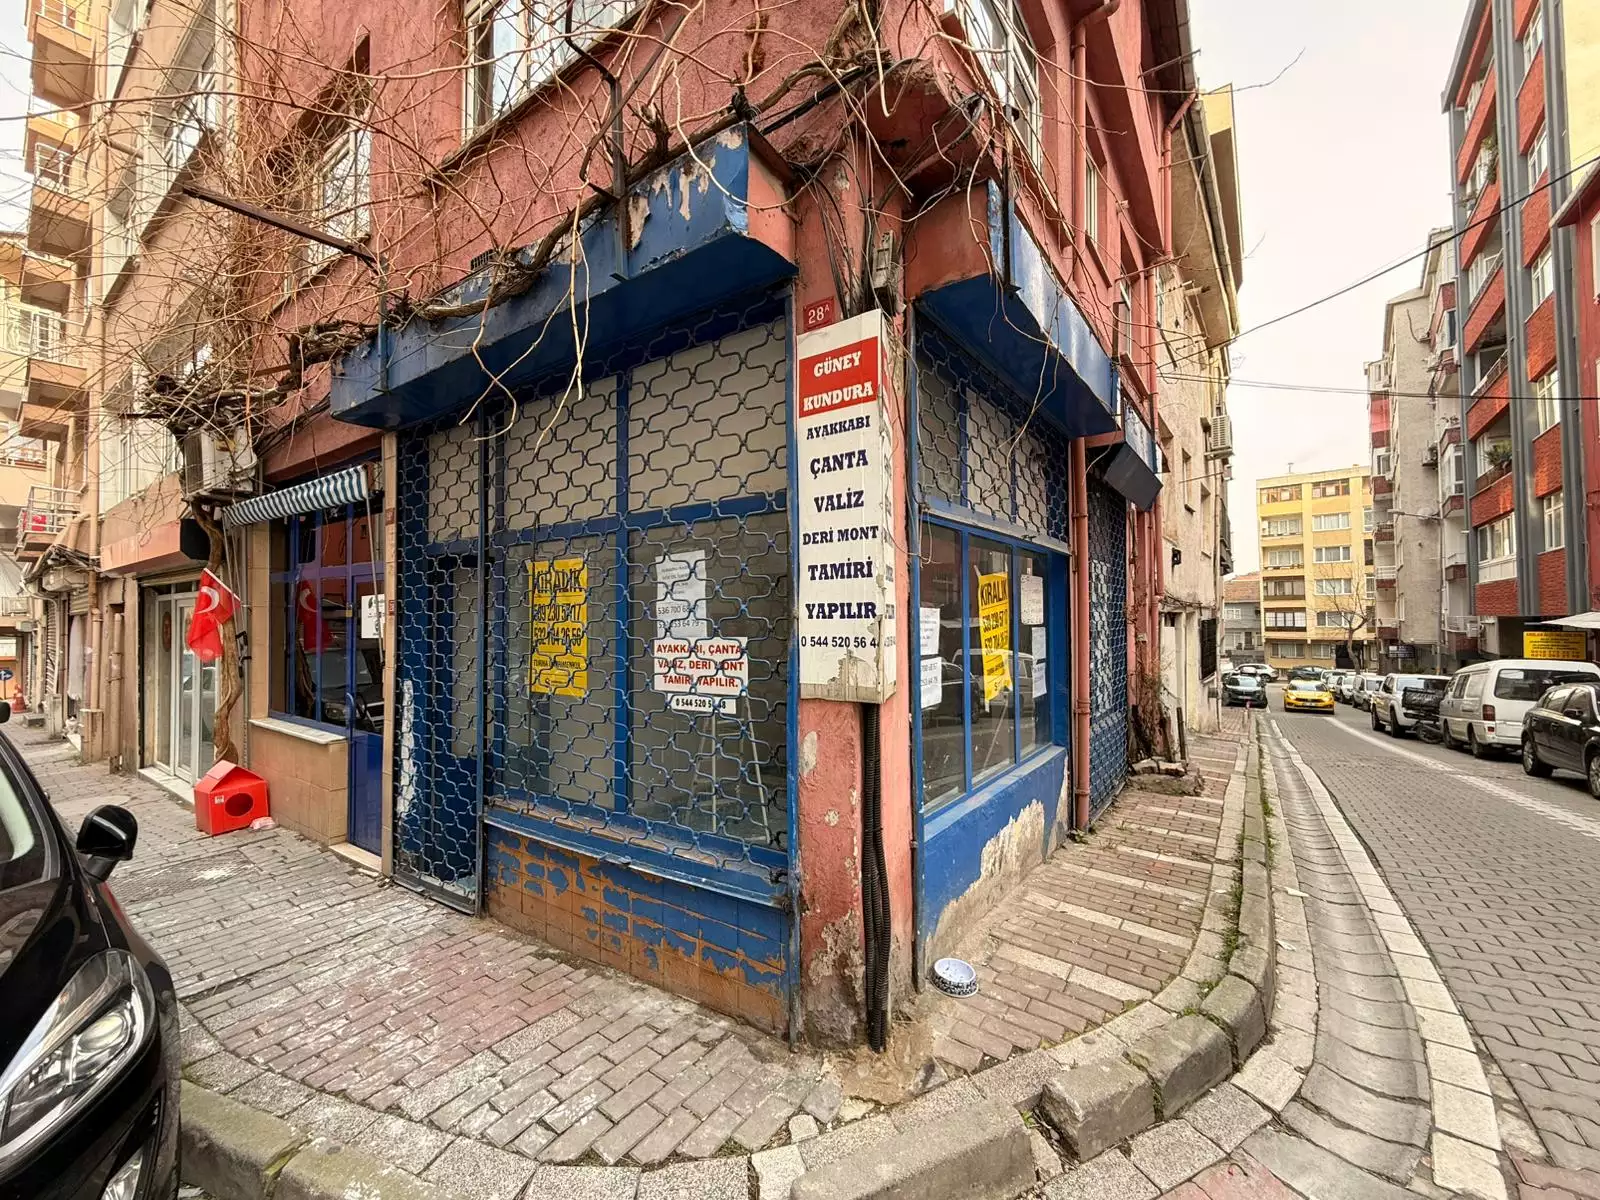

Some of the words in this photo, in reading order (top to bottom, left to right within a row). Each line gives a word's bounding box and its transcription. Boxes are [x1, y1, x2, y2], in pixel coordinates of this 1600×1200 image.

[813, 351, 862, 378] GÜNEY
[803, 381, 874, 412] KUNDURA
[806, 415, 871, 440] AYAKKABI
[810, 449, 869, 480] ÇANTA
[813, 487, 865, 513] VALİZ
[802, 526, 834, 546] DERİ
[837, 525, 879, 543] MONT
[807, 556, 874, 581] TAMİRİ
[805, 601, 877, 620] YAPILIR
[656, 644, 706, 655] AYAKKBI,
[800, 635, 807, 647] 0
[809, 635, 829, 648] 544
[831, 636, 851, 649] 520
[853, 636, 867, 649] 56
[714, 661, 745, 671] ONT
[681, 698, 694, 707] 544
[694, 698, 707, 708] 520
